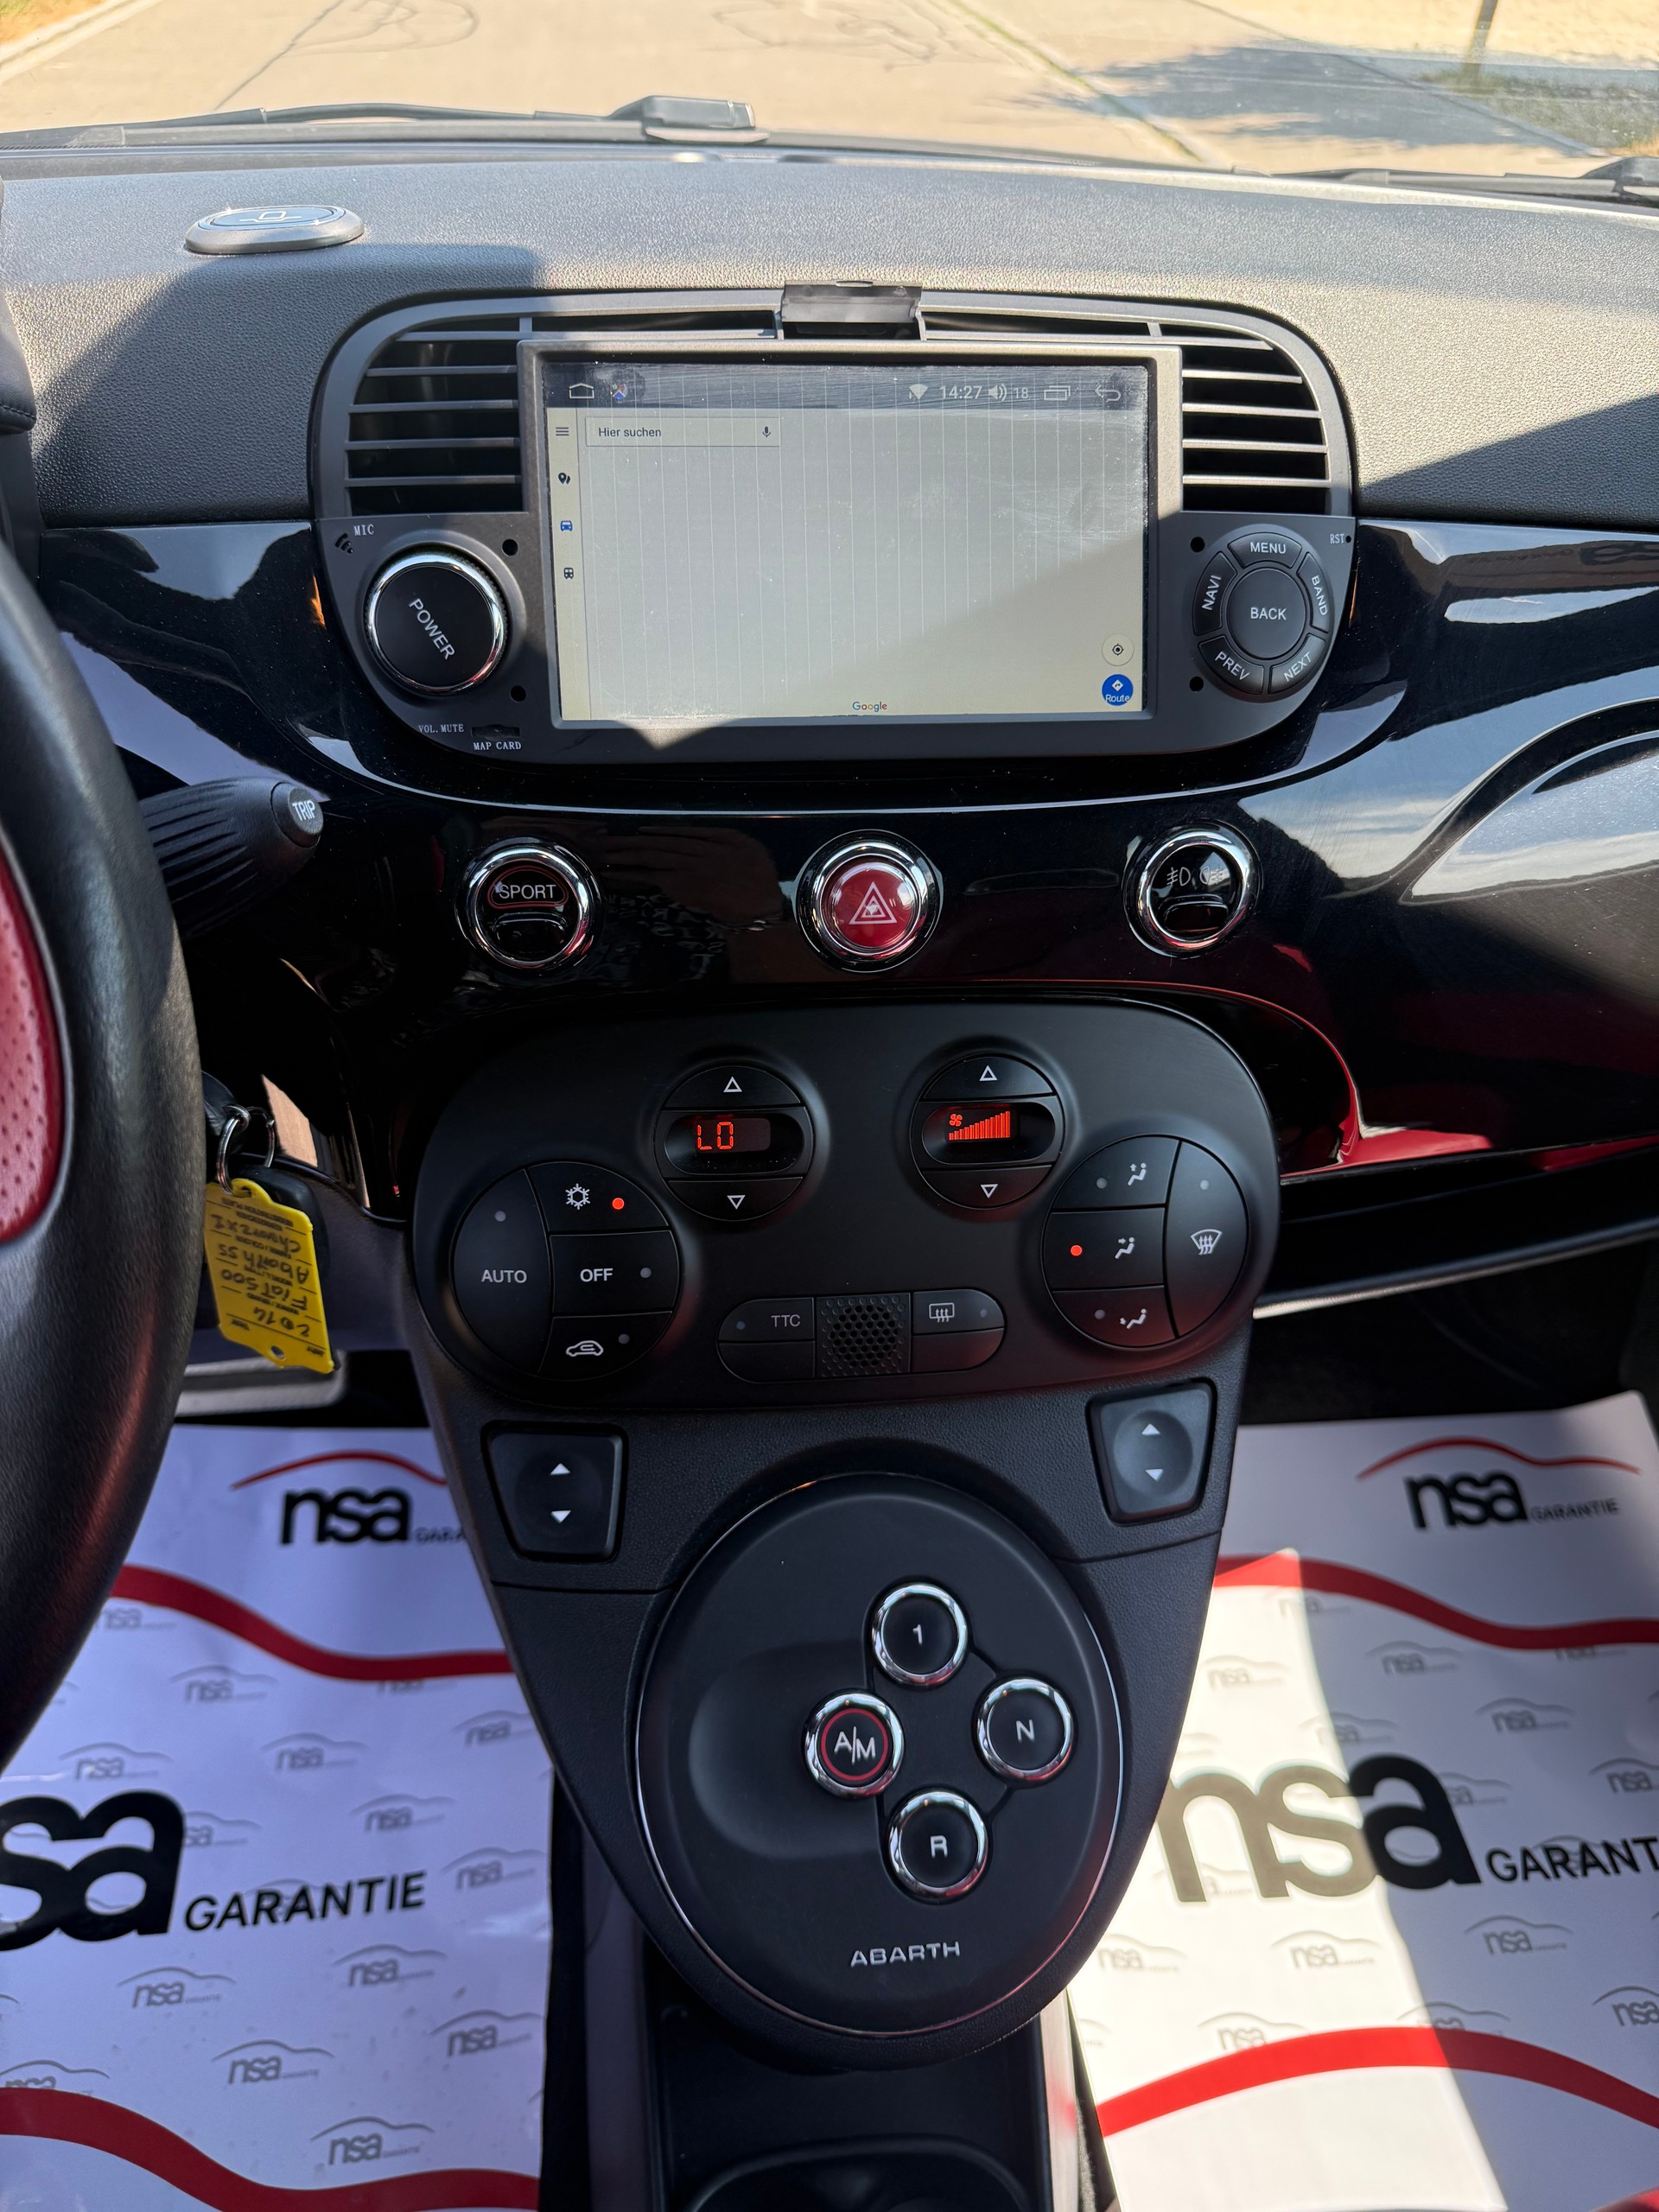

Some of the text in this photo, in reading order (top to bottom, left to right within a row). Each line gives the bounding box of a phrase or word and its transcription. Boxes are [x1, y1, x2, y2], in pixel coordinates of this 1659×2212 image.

[939, 385, 1030, 400] 14:27 18
[598, 420, 662, 437] Hier suchen
[353, 524, 375, 537] MIC
[1329, 533, 1345, 544] RST
[1249, 542, 1287, 555] MENU
[1202, 575, 1222, 611] NAVI
[1311, 575, 1329, 616] BAND
[1249, 607, 1287, 621] BACK
[409, 598, 455, 660] POWER
[1214, 651, 1249, 681] PREV
[1283, 652, 1312, 682] NEXT
[852, 700, 888, 713] Google
[1105, 693, 1130, 704] Route
[441, 723, 465, 734] MUTE
[473, 741, 523, 752] MAP CARD
[292, 799, 315, 822] TRIP
[498, 883, 557, 899] SPORT
[221, 1268, 259, 1291] 500
[481, 1269, 527, 1284] AUTO
[580, 1268, 613, 1282] OFF
[771, 1314, 801, 1328] TTC
[1404, 1472, 1621, 1530] nsa GARANTIE
[279, 1487, 413, 1546] nsa
[912, 1623, 924, 1644] 1
[1016, 1719, 1035, 1744] N
[834, 1726, 876, 1765] A/M
[1155, 1752, 1482, 1904] nsa
[930, 1834, 949, 1858] R
[184, 1869, 427, 1932] GARANTIE
[1483, 1930, 1534, 1955] nsa
[850, 1941, 961, 1968] ABARTH
[131, 1981, 185, 2009] nsa
[227, 2056, 283, 2085] nsa
[327, 2133, 384, 2166] nsa
